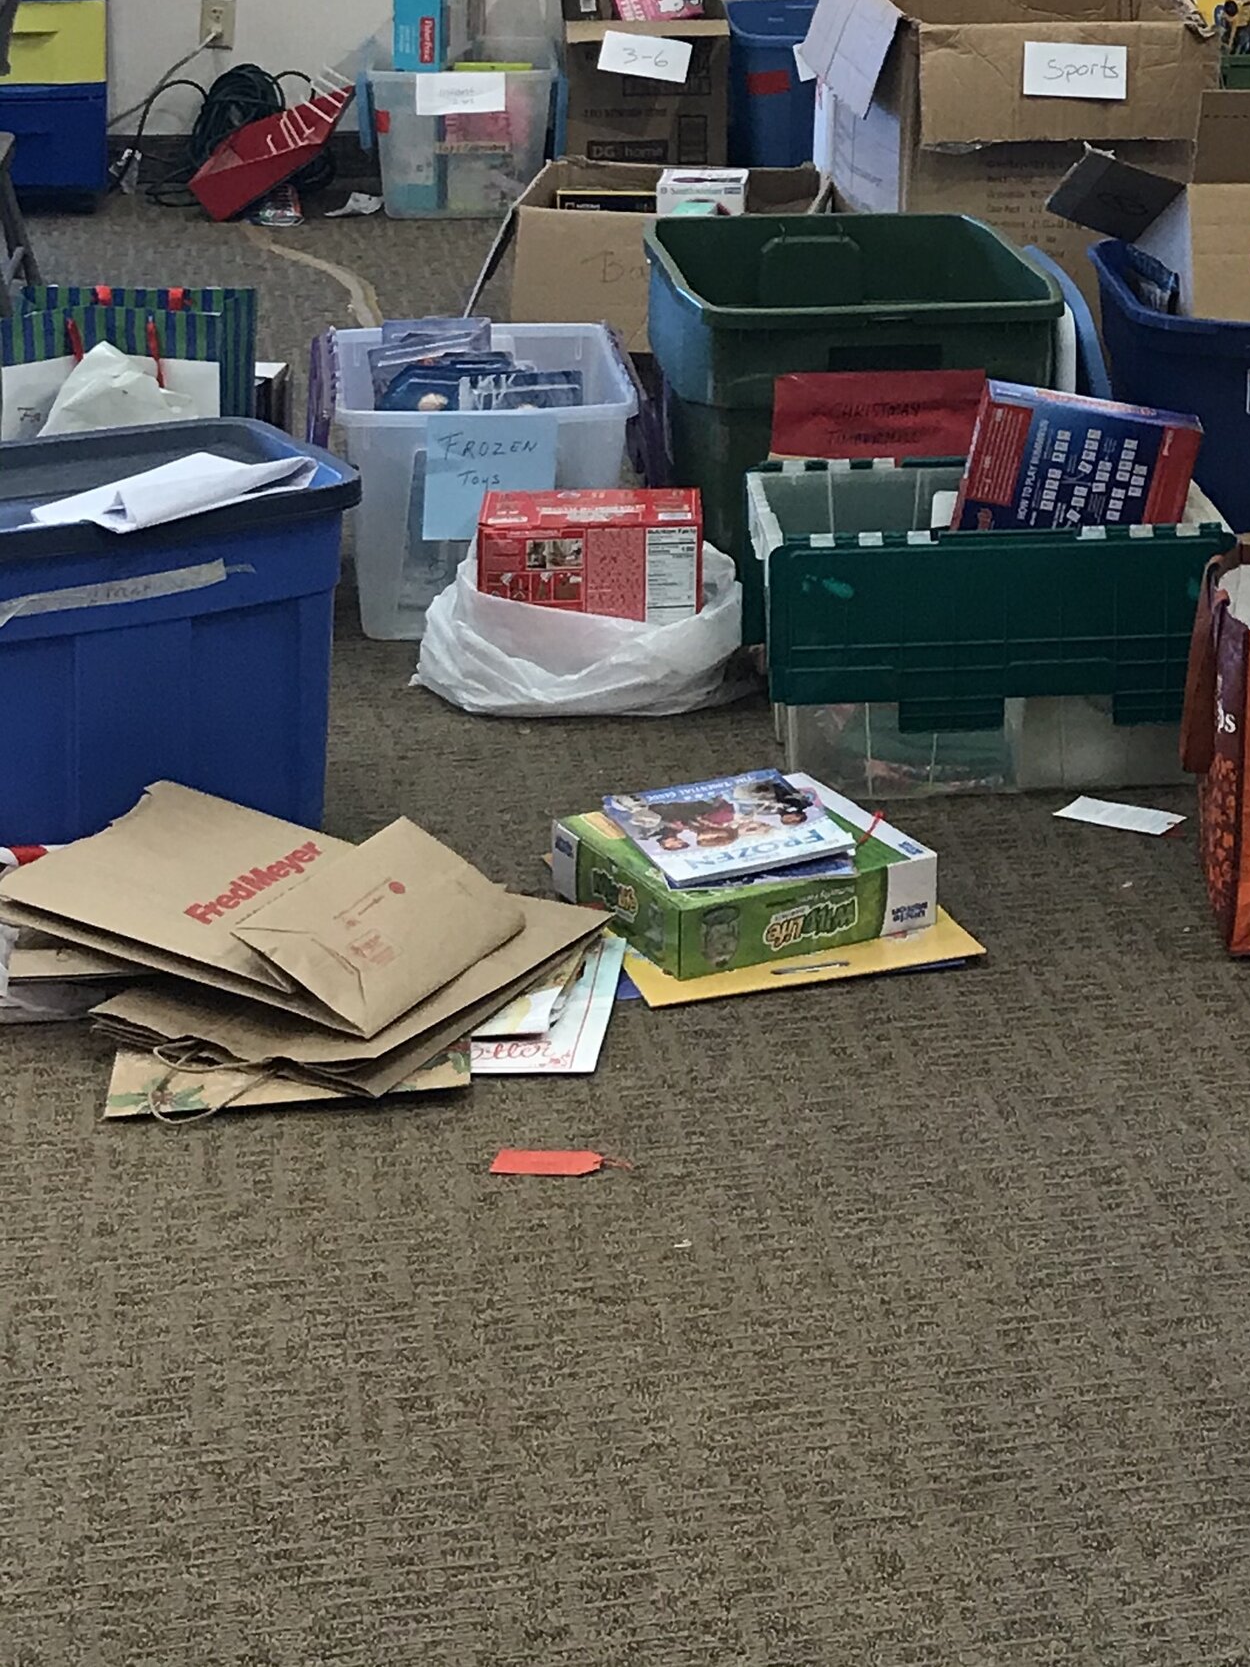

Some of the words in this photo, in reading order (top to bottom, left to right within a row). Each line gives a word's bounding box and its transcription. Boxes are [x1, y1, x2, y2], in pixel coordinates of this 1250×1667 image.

[622, 47, 669, 68] 3-6
[1043, 54, 1120, 84] Sports
[437, 431, 538, 461] FROZEN
[458, 469, 501, 489] Toys
